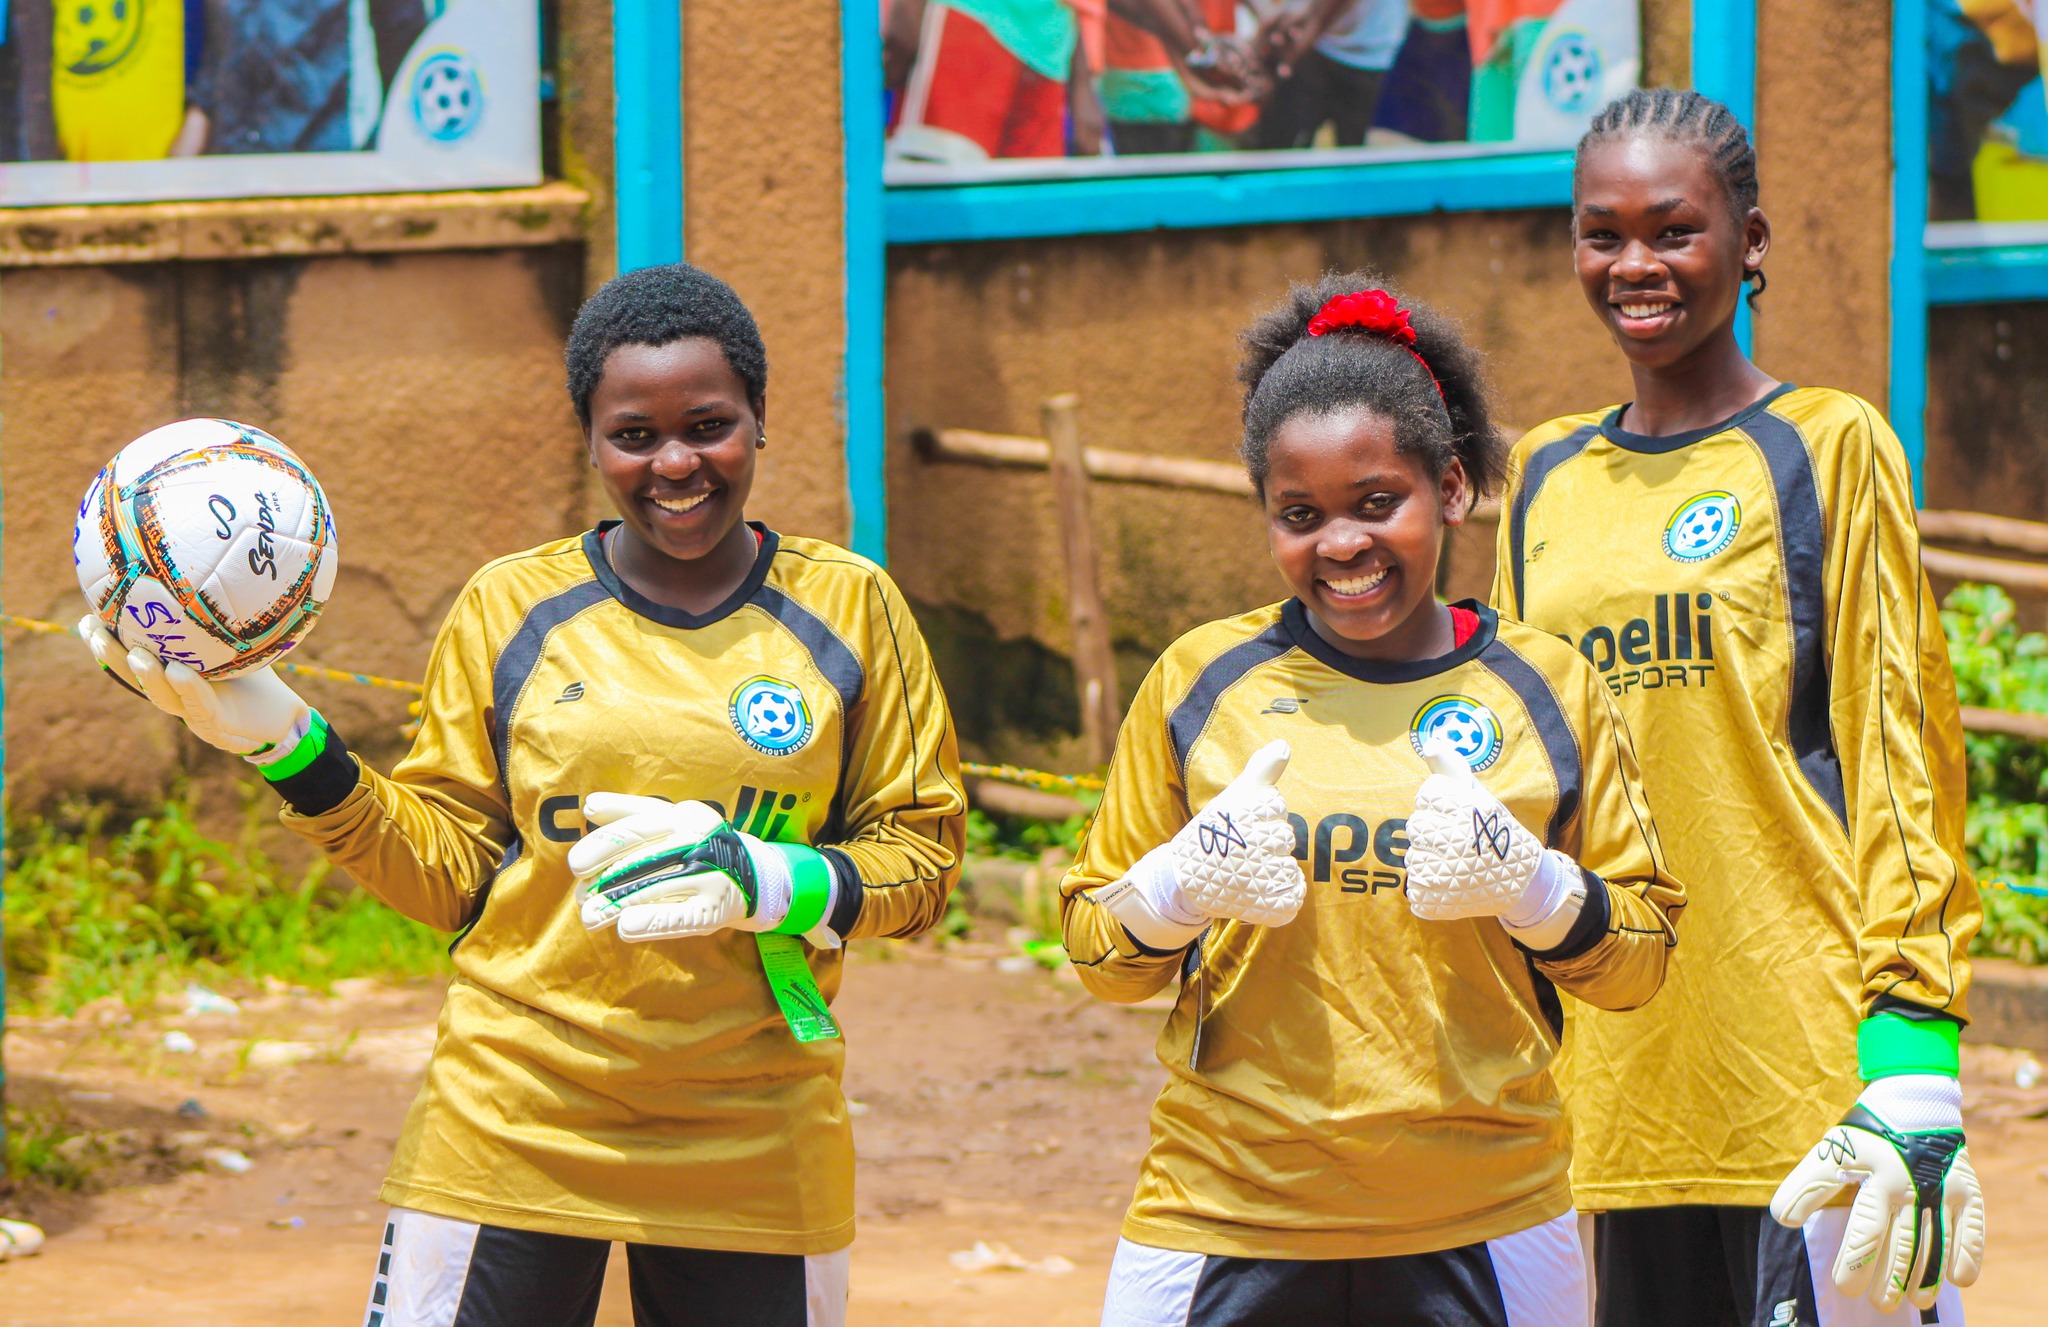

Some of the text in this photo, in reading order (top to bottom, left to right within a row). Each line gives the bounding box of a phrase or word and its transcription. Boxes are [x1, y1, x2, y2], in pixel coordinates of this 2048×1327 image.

[271, 491, 281, 513] APEX
[1662, 525, 1738, 563] SOCCER WITHOUT BORDERS
[1606, 665, 1715, 697] SPORT
[728, 706, 812, 756] SOCCER WITHOUT BORDERS
[1474, 740, 1501, 772] BORDERS
